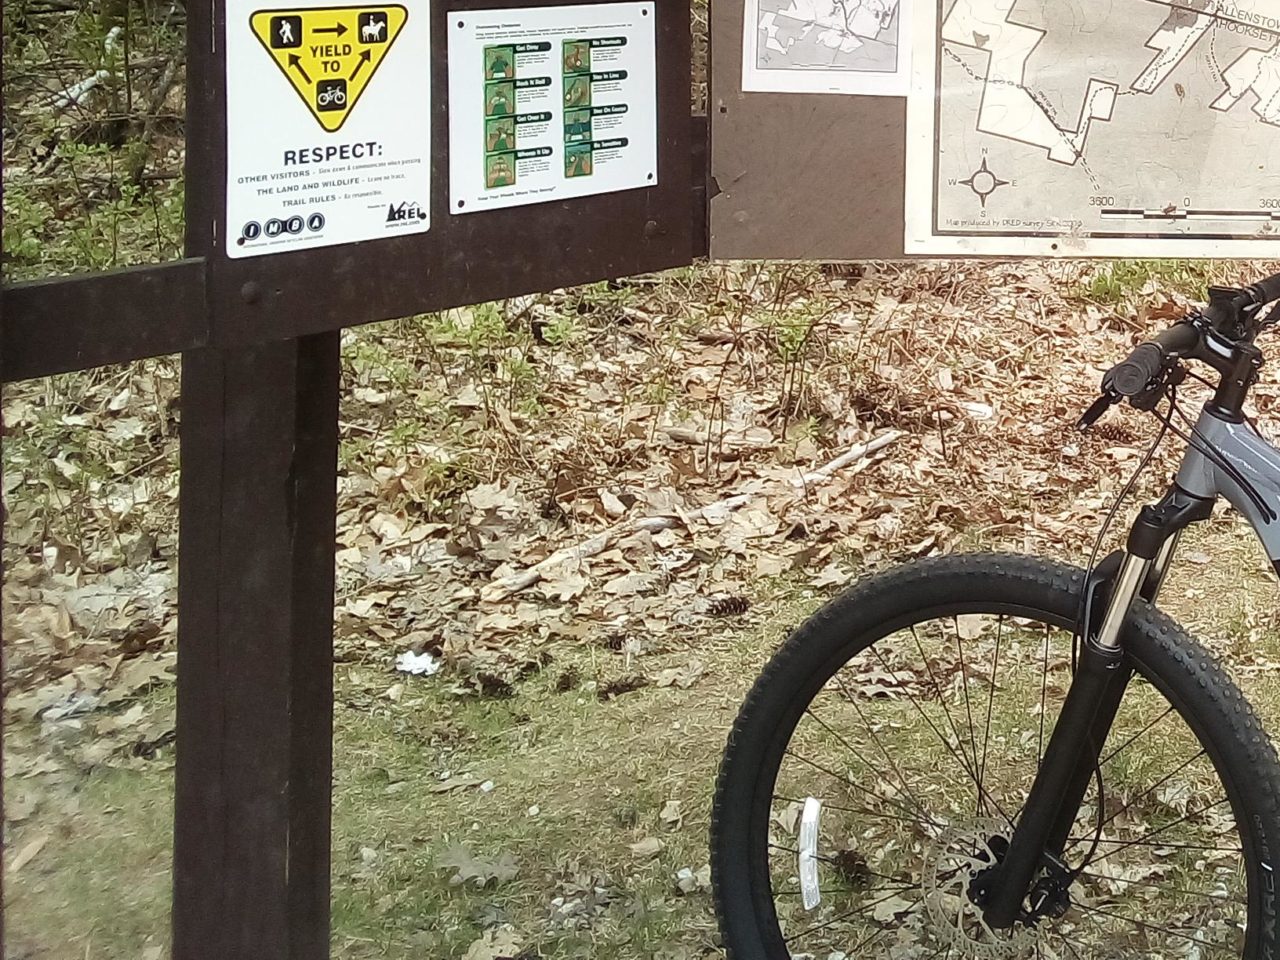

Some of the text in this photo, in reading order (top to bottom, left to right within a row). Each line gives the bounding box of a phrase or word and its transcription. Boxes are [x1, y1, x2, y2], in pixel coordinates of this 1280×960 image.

[309, 44, 352, 58] YIELD
[321, 60, 341, 73] TO
[284, 141, 383, 166] RESPECT:
[237, 170, 310, 184] OTHER VISITORS
[257, 188, 273, 196] THE
[276, 185, 299, 194] LAND
[302, 182, 319, 191] AND
[322, 178, 360, 189] WILDLIFE
[282, 198, 306, 208] TRAIL
[309, 195, 336, 205] RULES
[1088, 196, 1114, 206] 3600
[1183, 197, 1191, 207] 0
